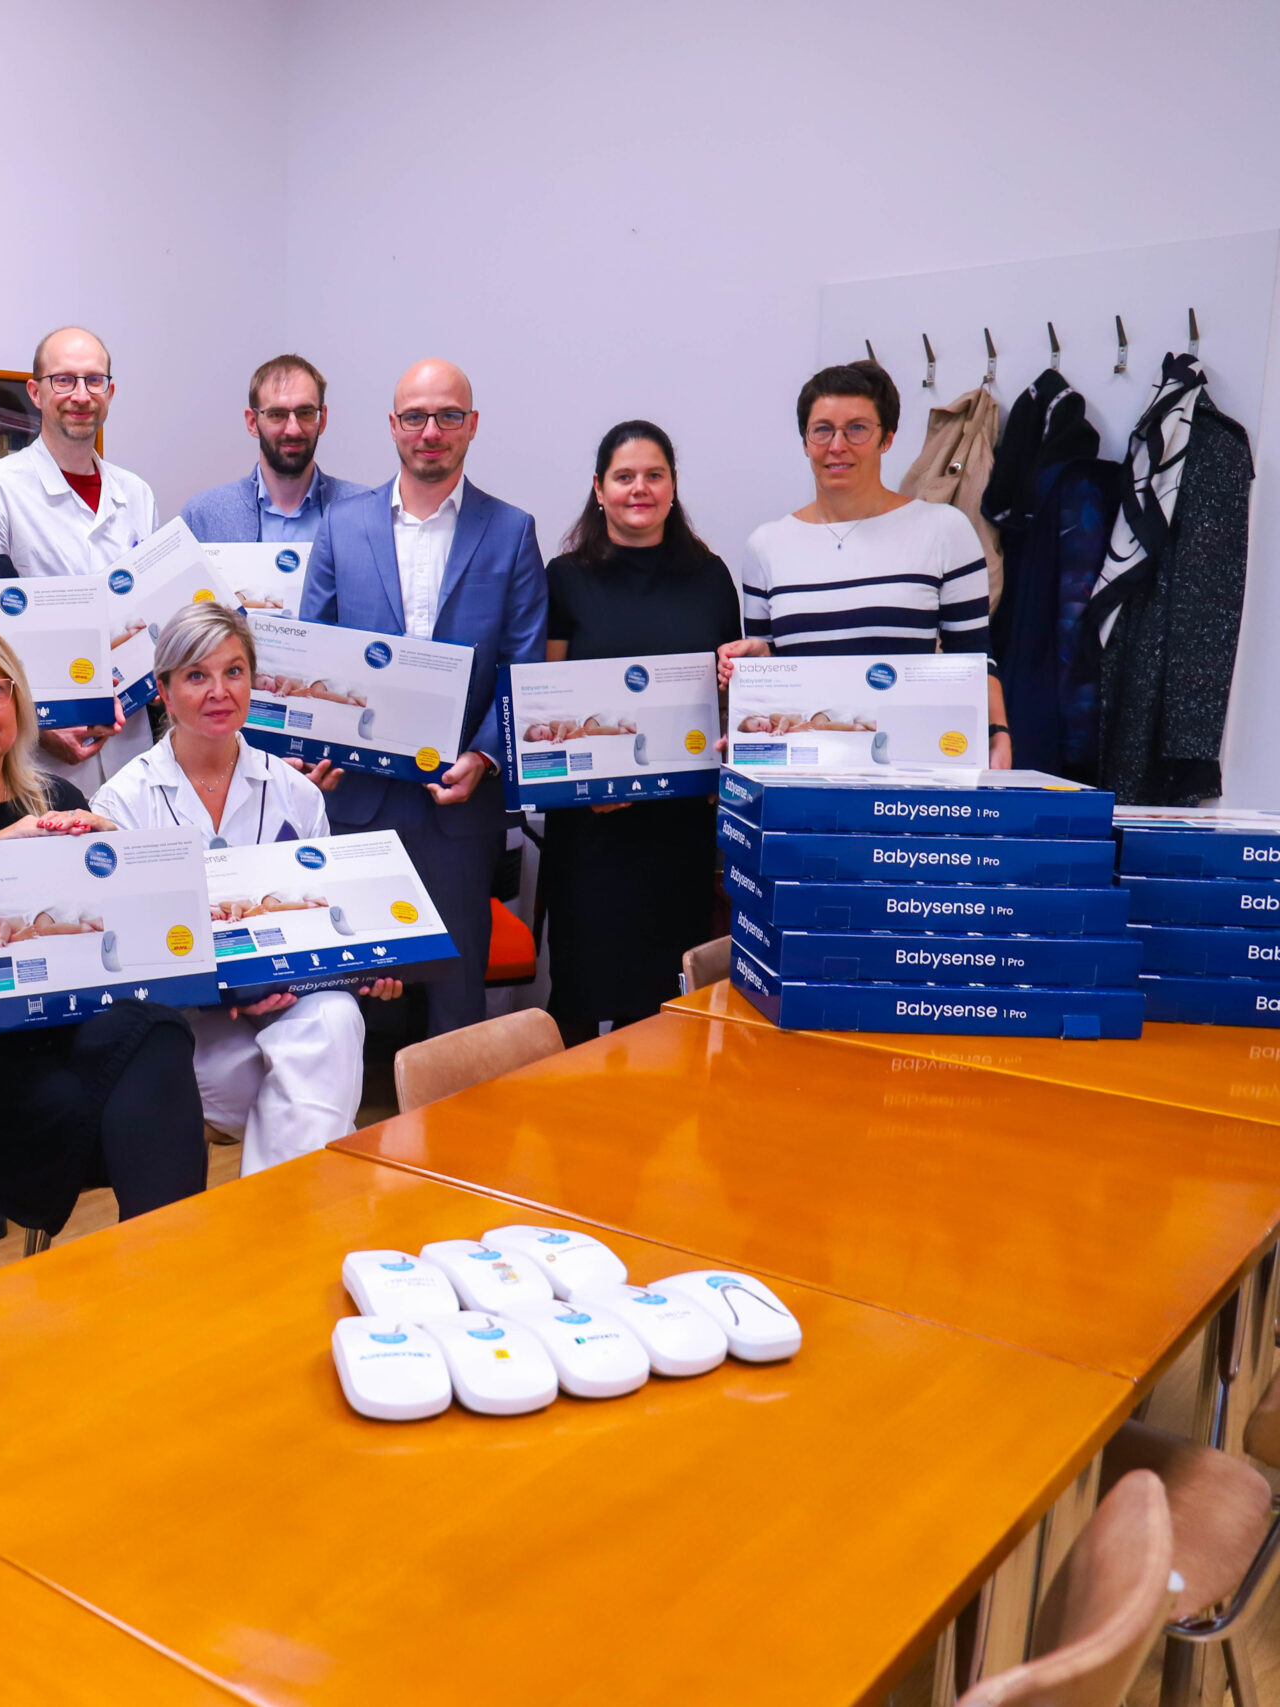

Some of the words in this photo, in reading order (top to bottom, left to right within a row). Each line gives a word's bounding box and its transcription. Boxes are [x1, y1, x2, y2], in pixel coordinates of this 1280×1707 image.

[254, 620, 307, 638] babysense
[739, 663, 799, 674] babysense
[502, 696, 512, 763] Babysense
[725, 777, 748, 802] Babysense
[873, 801, 971, 820] Babysense
[977, 808, 980, 818] 1
[983, 809, 1000, 818] Pro
[722, 820, 746, 845] Babysense
[873, 849, 971, 868] Babysense
[977, 857, 980, 866] 1
[983, 857, 1000, 866] Pro
[730, 865, 756, 894] Babysense
[886, 899, 985, 918] Babysense
[990, 906, 994, 915] 1
[996, 906, 1014, 916] Pro
[737, 911, 764, 942] Babysense
[895, 949, 996, 969] Babysense
[1001, 957, 1005, 967] 1
[1007, 957, 1025, 967] Pro
[736, 957, 763, 988] Babysense
[288, 977, 359, 993] Babysense
[896, 1001, 998, 1021] Babysense
[1003, 1008, 1007, 1018] 1
[1009, 1009, 1027, 1019] Pro
